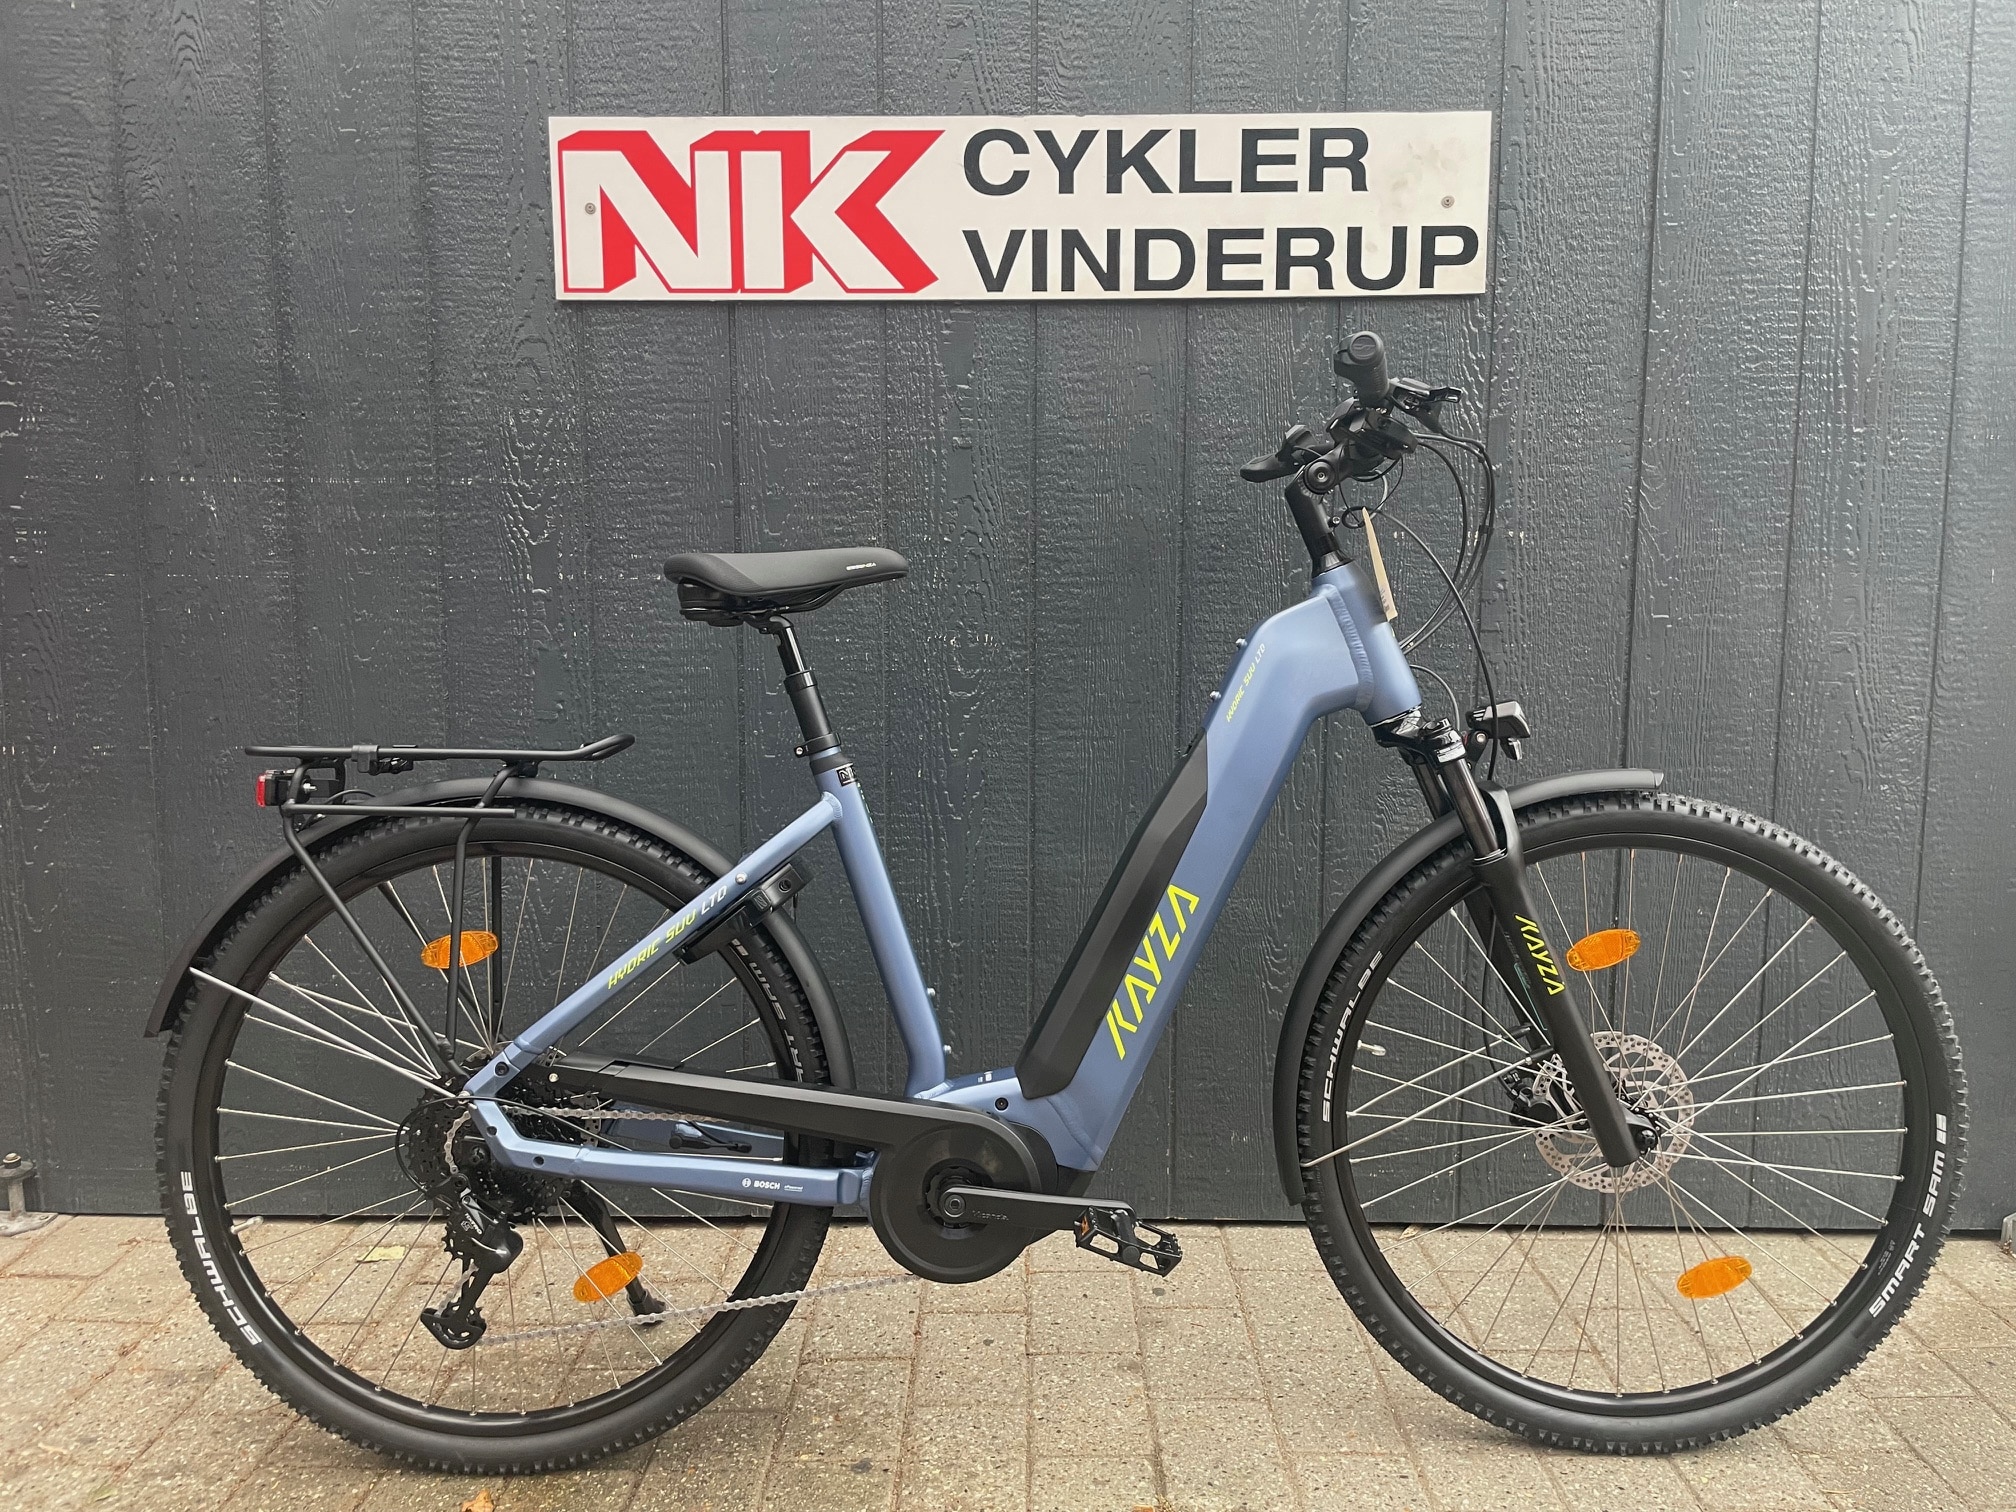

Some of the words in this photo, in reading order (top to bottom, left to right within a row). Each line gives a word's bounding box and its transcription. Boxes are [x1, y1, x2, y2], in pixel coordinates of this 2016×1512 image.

[558, 130, 945, 293] NK
[963, 127, 1369, 194] CYKLER
[962, 225, 1480, 292] VINDERUP
[607, 937, 660, 990] HYDRIC
[701, 885, 727, 915] LTD
[1106, 884, 1200, 1061] KAYZA
[1514, 914, 1566, 996] KAYZA
[1322, 950, 1383, 1123] SCHWALBE
[753, 1180, 781, 1190] BOSCH
[1868, 1222, 1926, 1318] SMART
[1922, 1150, 1946, 1218] SAM
[180, 1171, 263, 1346] SCHWALBE
